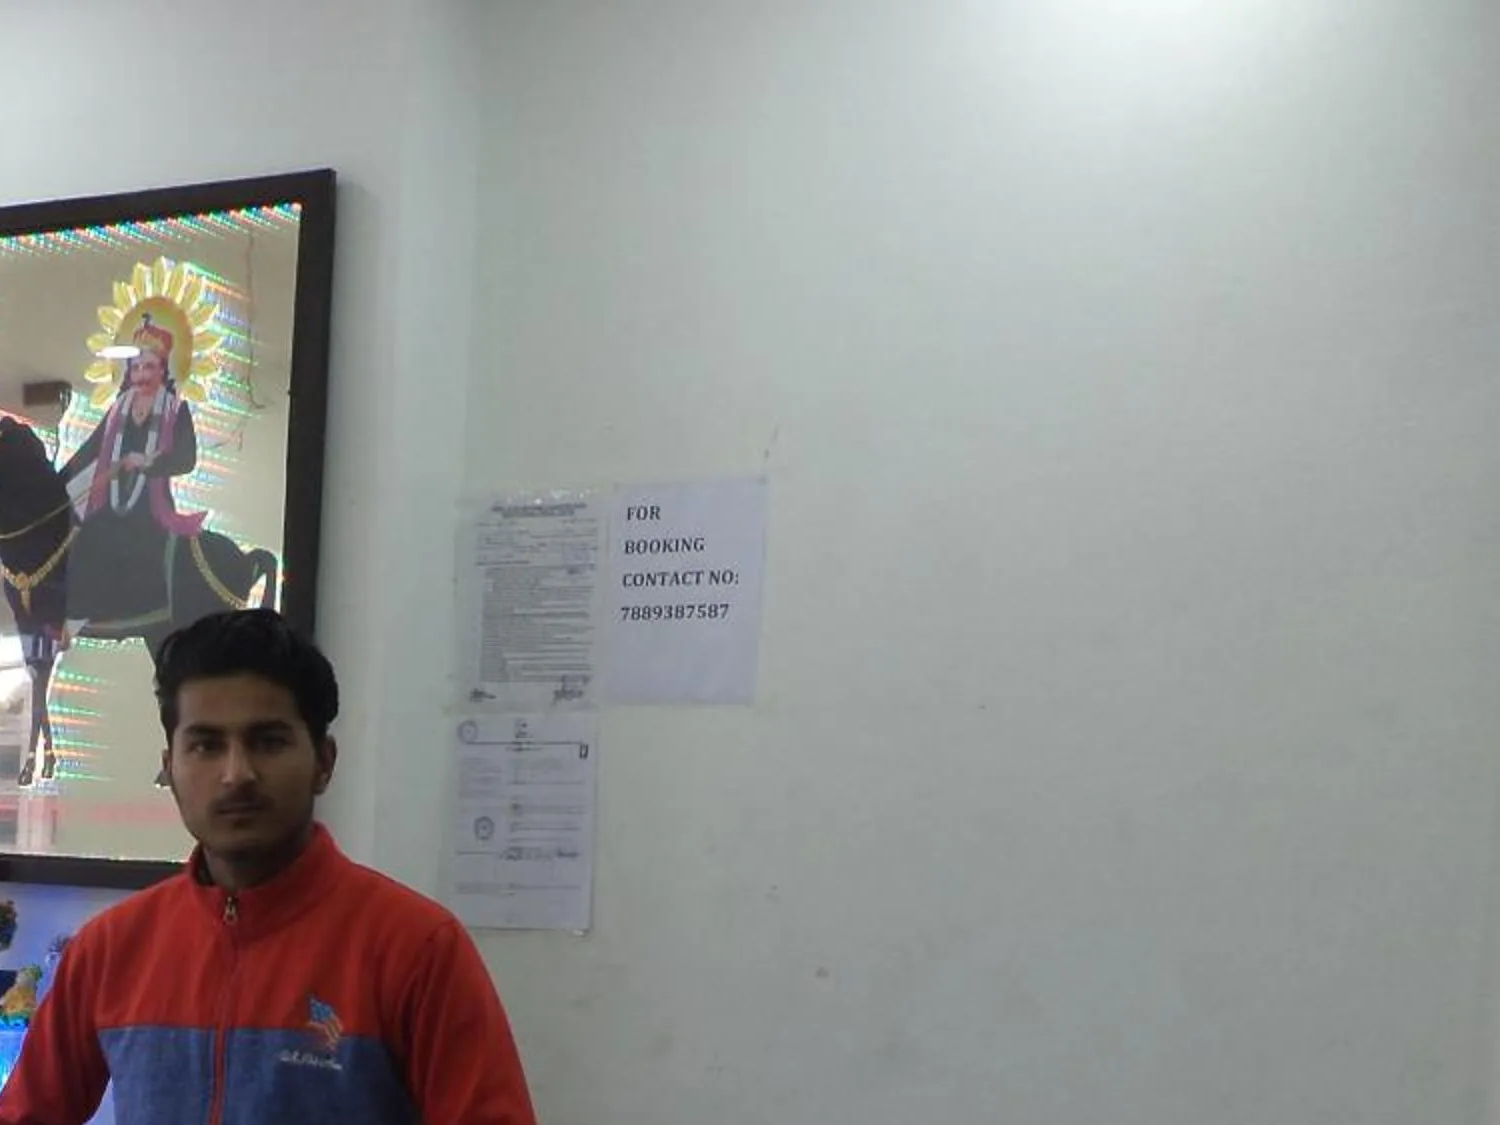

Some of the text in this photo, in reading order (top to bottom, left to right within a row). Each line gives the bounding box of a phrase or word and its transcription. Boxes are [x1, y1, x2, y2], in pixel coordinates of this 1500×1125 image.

[626, 505, 661, 521] FOR
[623, 537, 705, 555] BOOKING
[622, 568, 739, 588] CONTACT NO:
[620, 603, 730, 620] 7889387587
